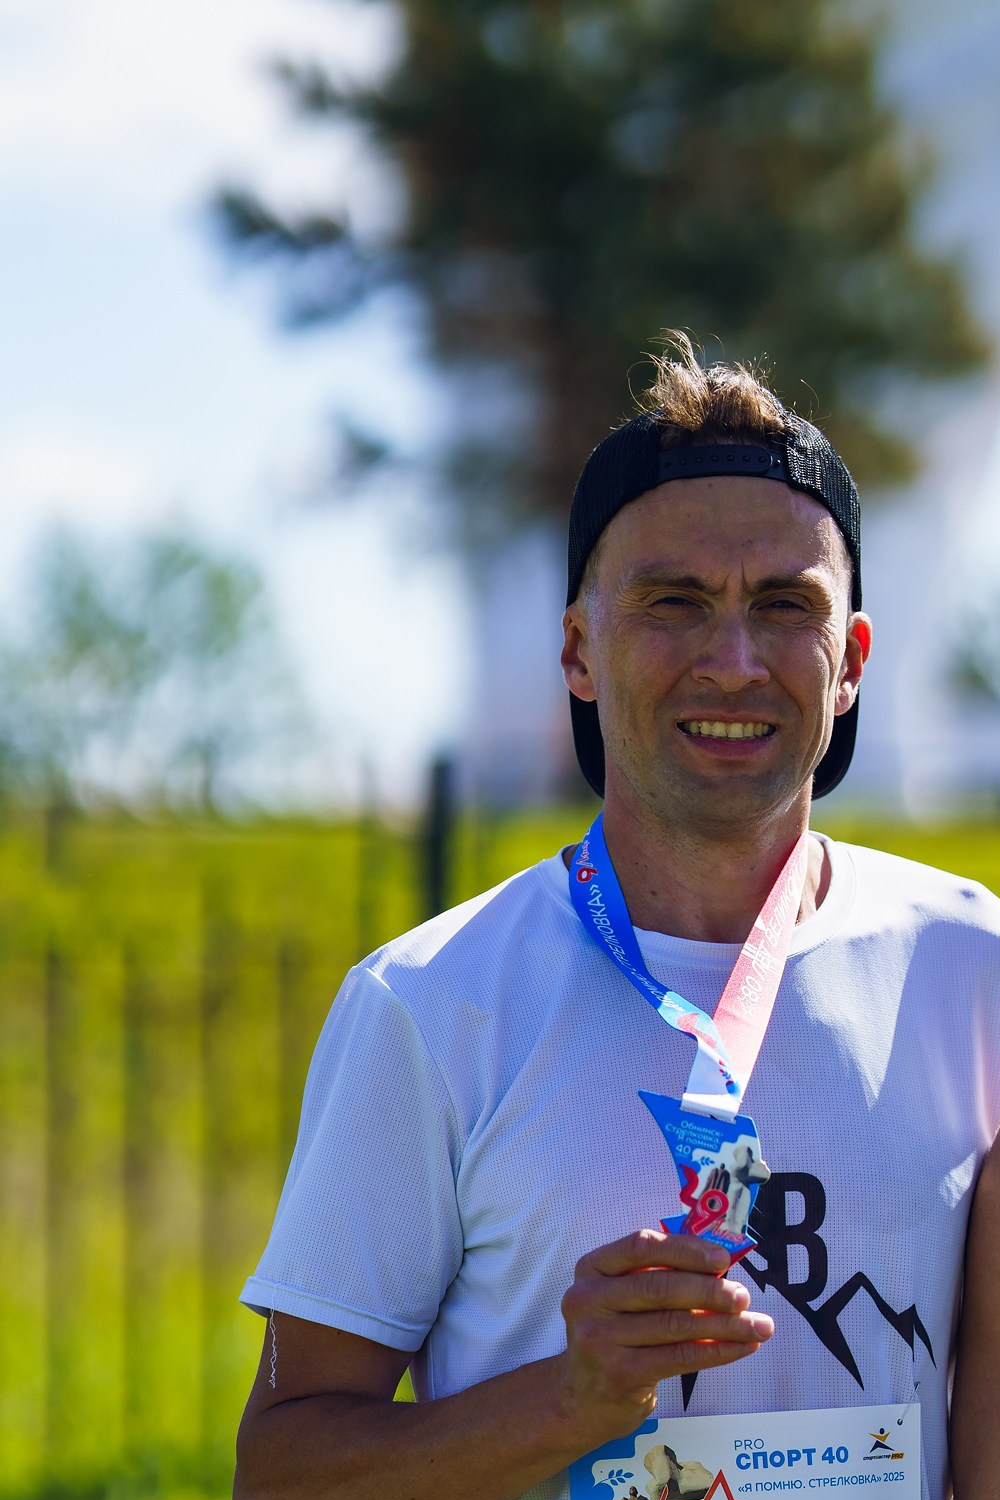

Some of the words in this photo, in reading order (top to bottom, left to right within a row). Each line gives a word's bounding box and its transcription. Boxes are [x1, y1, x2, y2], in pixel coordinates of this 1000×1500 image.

[676, 1144, 691, 1155] 40
[734, 1438, 765, 1450] PRO
[735, 1448, 816, 1471] СПОРТ
[821, 1446, 849, 1465] 40
[738, 1483, 752, 1493] «Я
[755, 1480, 806, 1492] ПОМНЮ.
[808, 1474, 881, 1488] СТРЕЛКОВКА»
[883, 1472, 905, 1481] 2025
